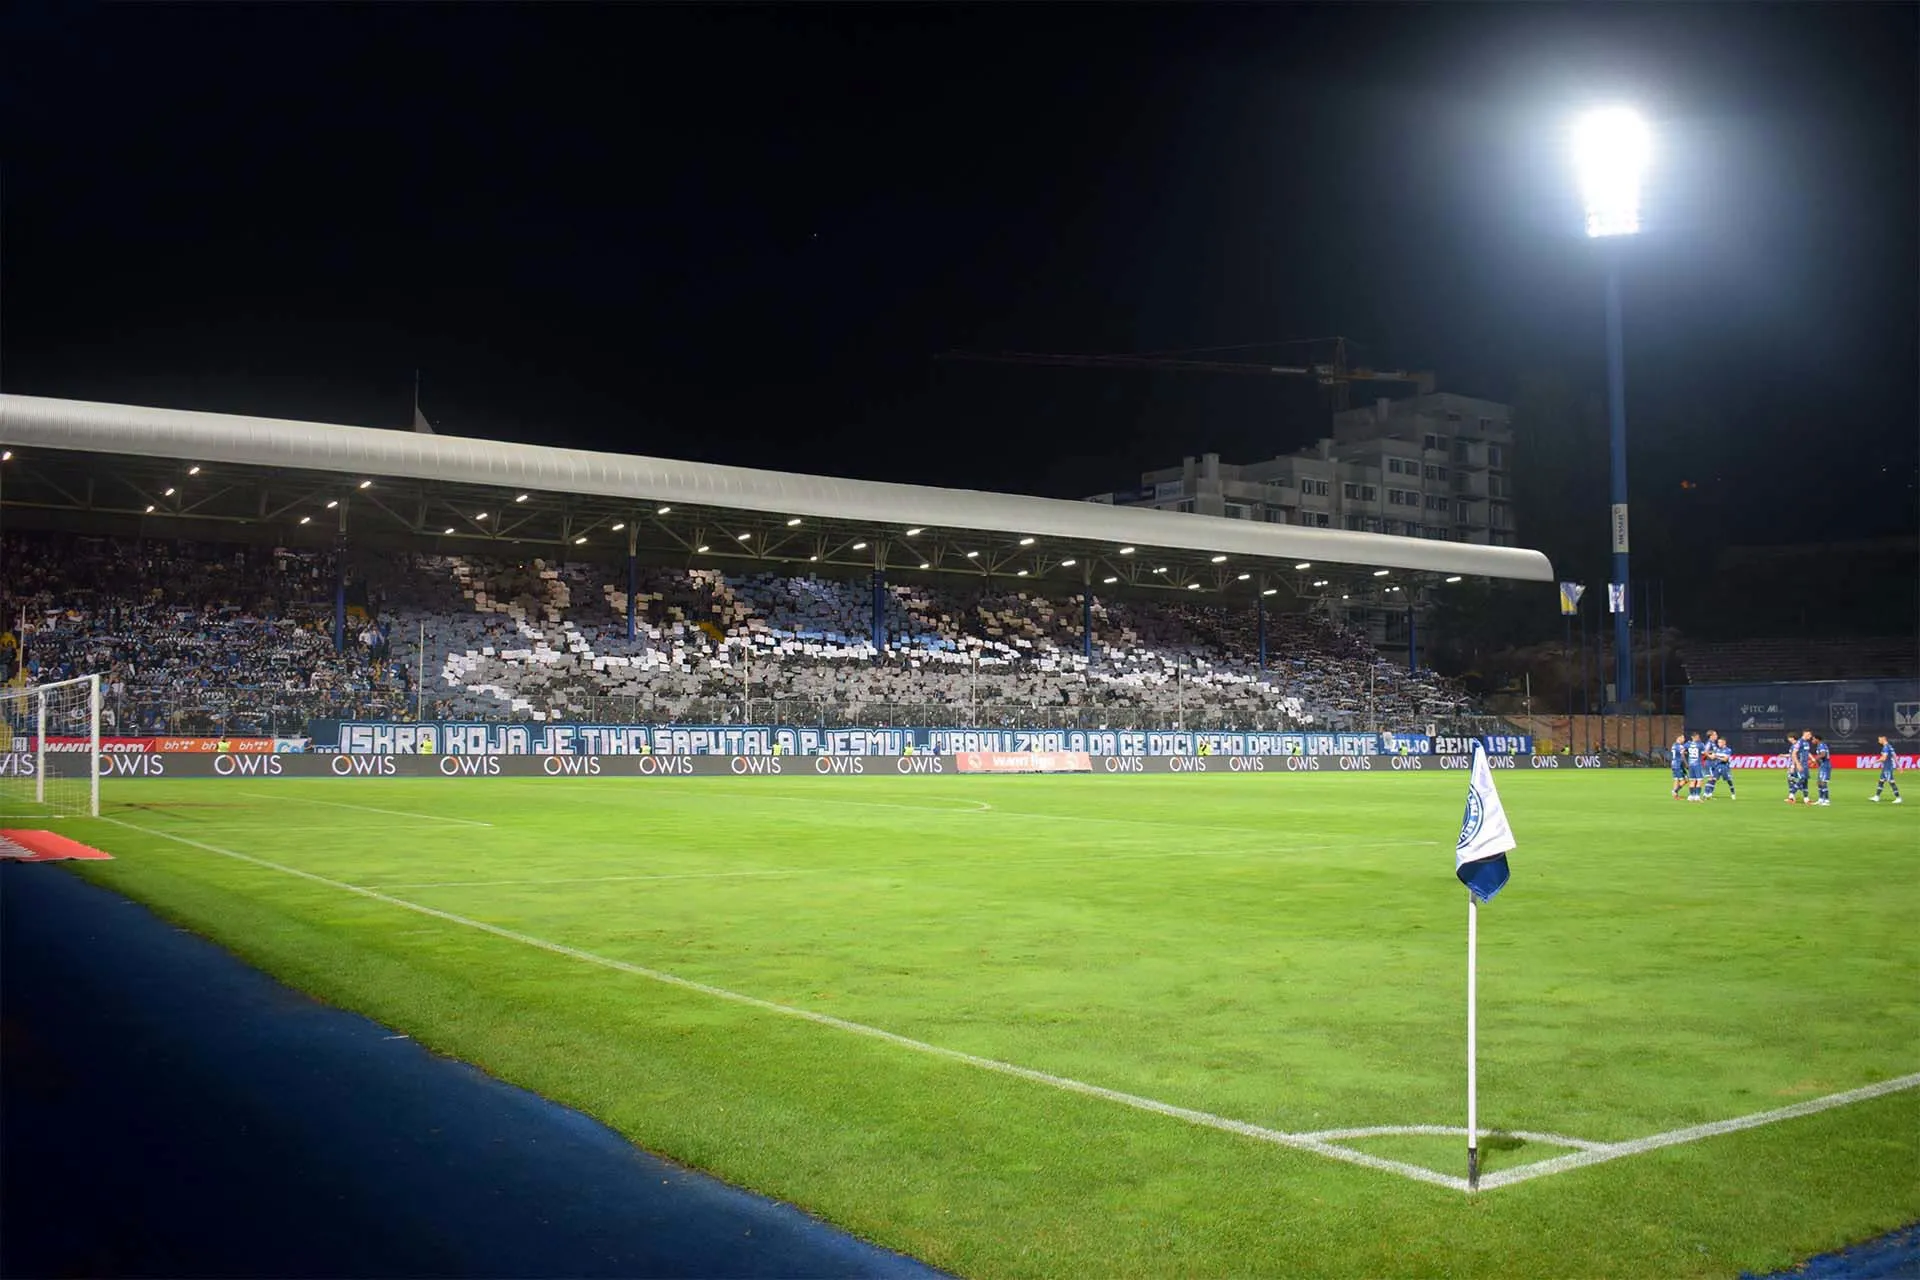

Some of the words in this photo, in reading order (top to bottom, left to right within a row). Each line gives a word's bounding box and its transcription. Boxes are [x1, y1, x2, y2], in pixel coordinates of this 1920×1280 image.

[444, 725, 527, 754] KOJA
[535, 727, 575, 755] JE
[581, 728, 649, 755] TIHO
[801, 729, 900, 755] PJESMU
[1089, 733, 1116, 755] DA
[214, 754, 283, 775] OWIS
[332, 755, 396, 775] OWIS
[440, 756, 500, 775] OWIS
[544, 756, 600, 775] OWIS
[639, 756, 693, 774] OWIS
[731, 756, 782, 774] OWIS
[815, 756, 864, 774] OWIS
[897, 757, 943, 773] OWIS
[1105, 757, 1144, 772] OWIS
[1169, 757, 1206, 772] OWIS
[1229, 757, 1264, 772] OWIS
[1286, 757, 1319, 771] OWIS
[1339, 757, 1371, 771] OWIS
[1391, 756, 1421, 770] OWIS
[1440, 756, 1469, 769] OWIS
[1488, 756, 1515, 769] OWIS
[1531, 756, 1558, 768] OWIS
[1574, 756, 1600, 768] OWIS
